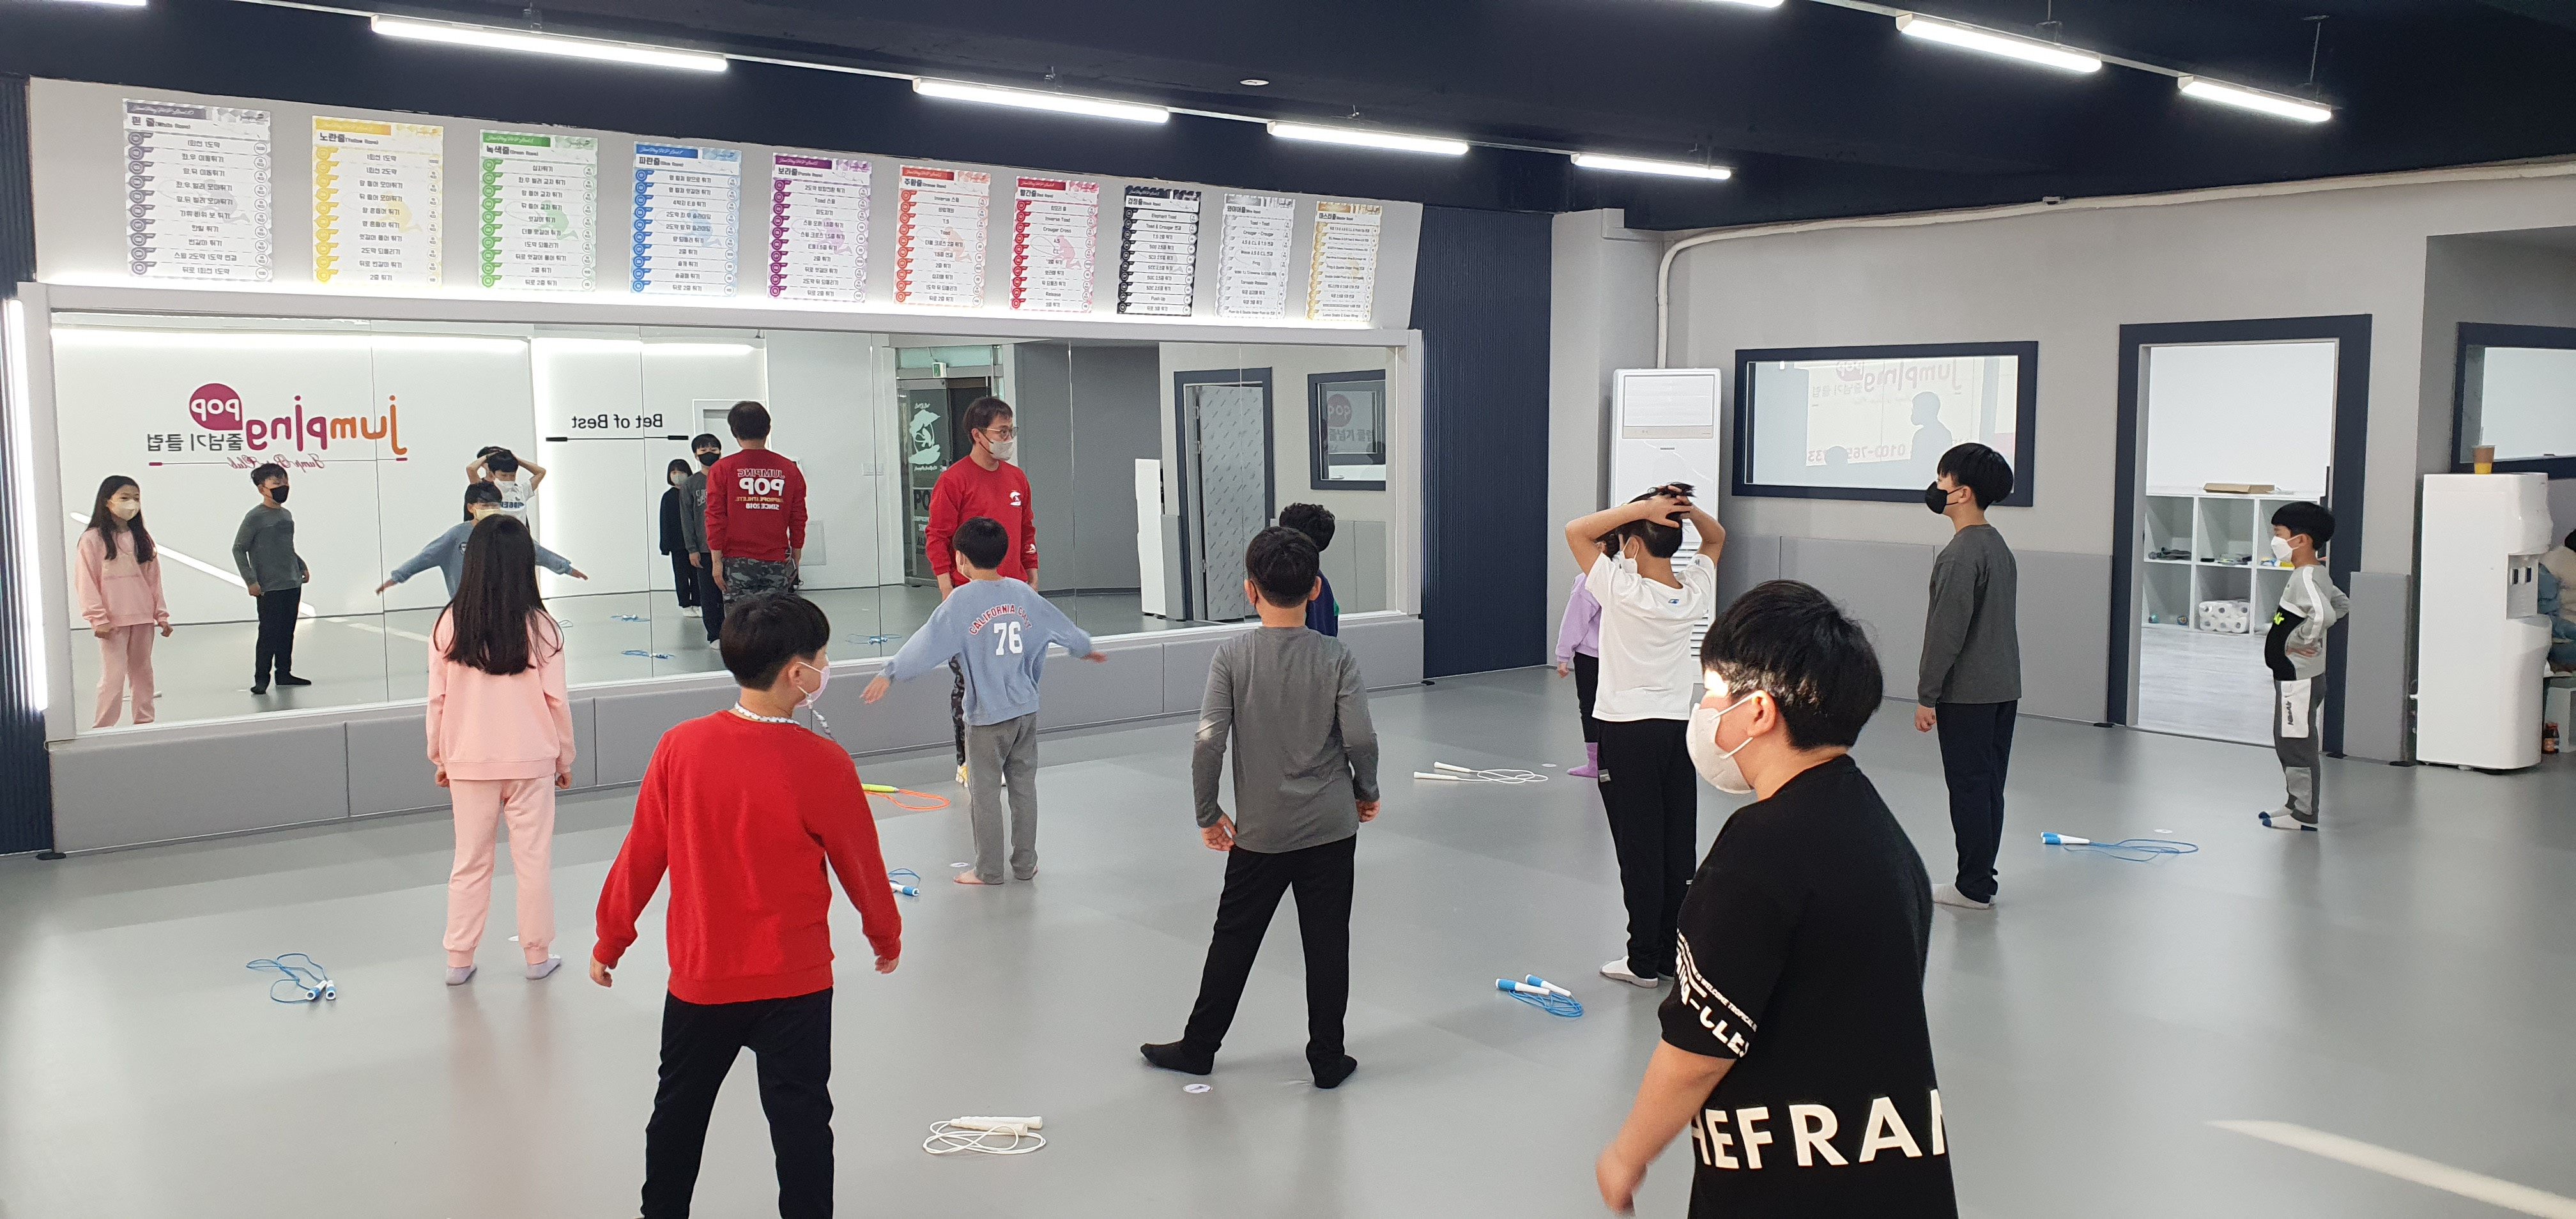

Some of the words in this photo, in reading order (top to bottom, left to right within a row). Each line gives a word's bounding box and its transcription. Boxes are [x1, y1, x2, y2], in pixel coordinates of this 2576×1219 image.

[319, 132, 345, 142] 노란줄
[486, 145, 509, 155] 녹색줄
[639, 157, 659, 165] 파란줄
[778, 168, 798, 176] 보라줄
[1020, 189, 1036, 197] 빨간줄
[914, 489, 931, 510] PO
[969, 603, 1016, 636] CALIFORNIA
[993, 621, 1023, 656] 76
[1701, 976, 1728, 1006] WELCOME
[1727, 1001, 1753, 1029] TROPICAL
